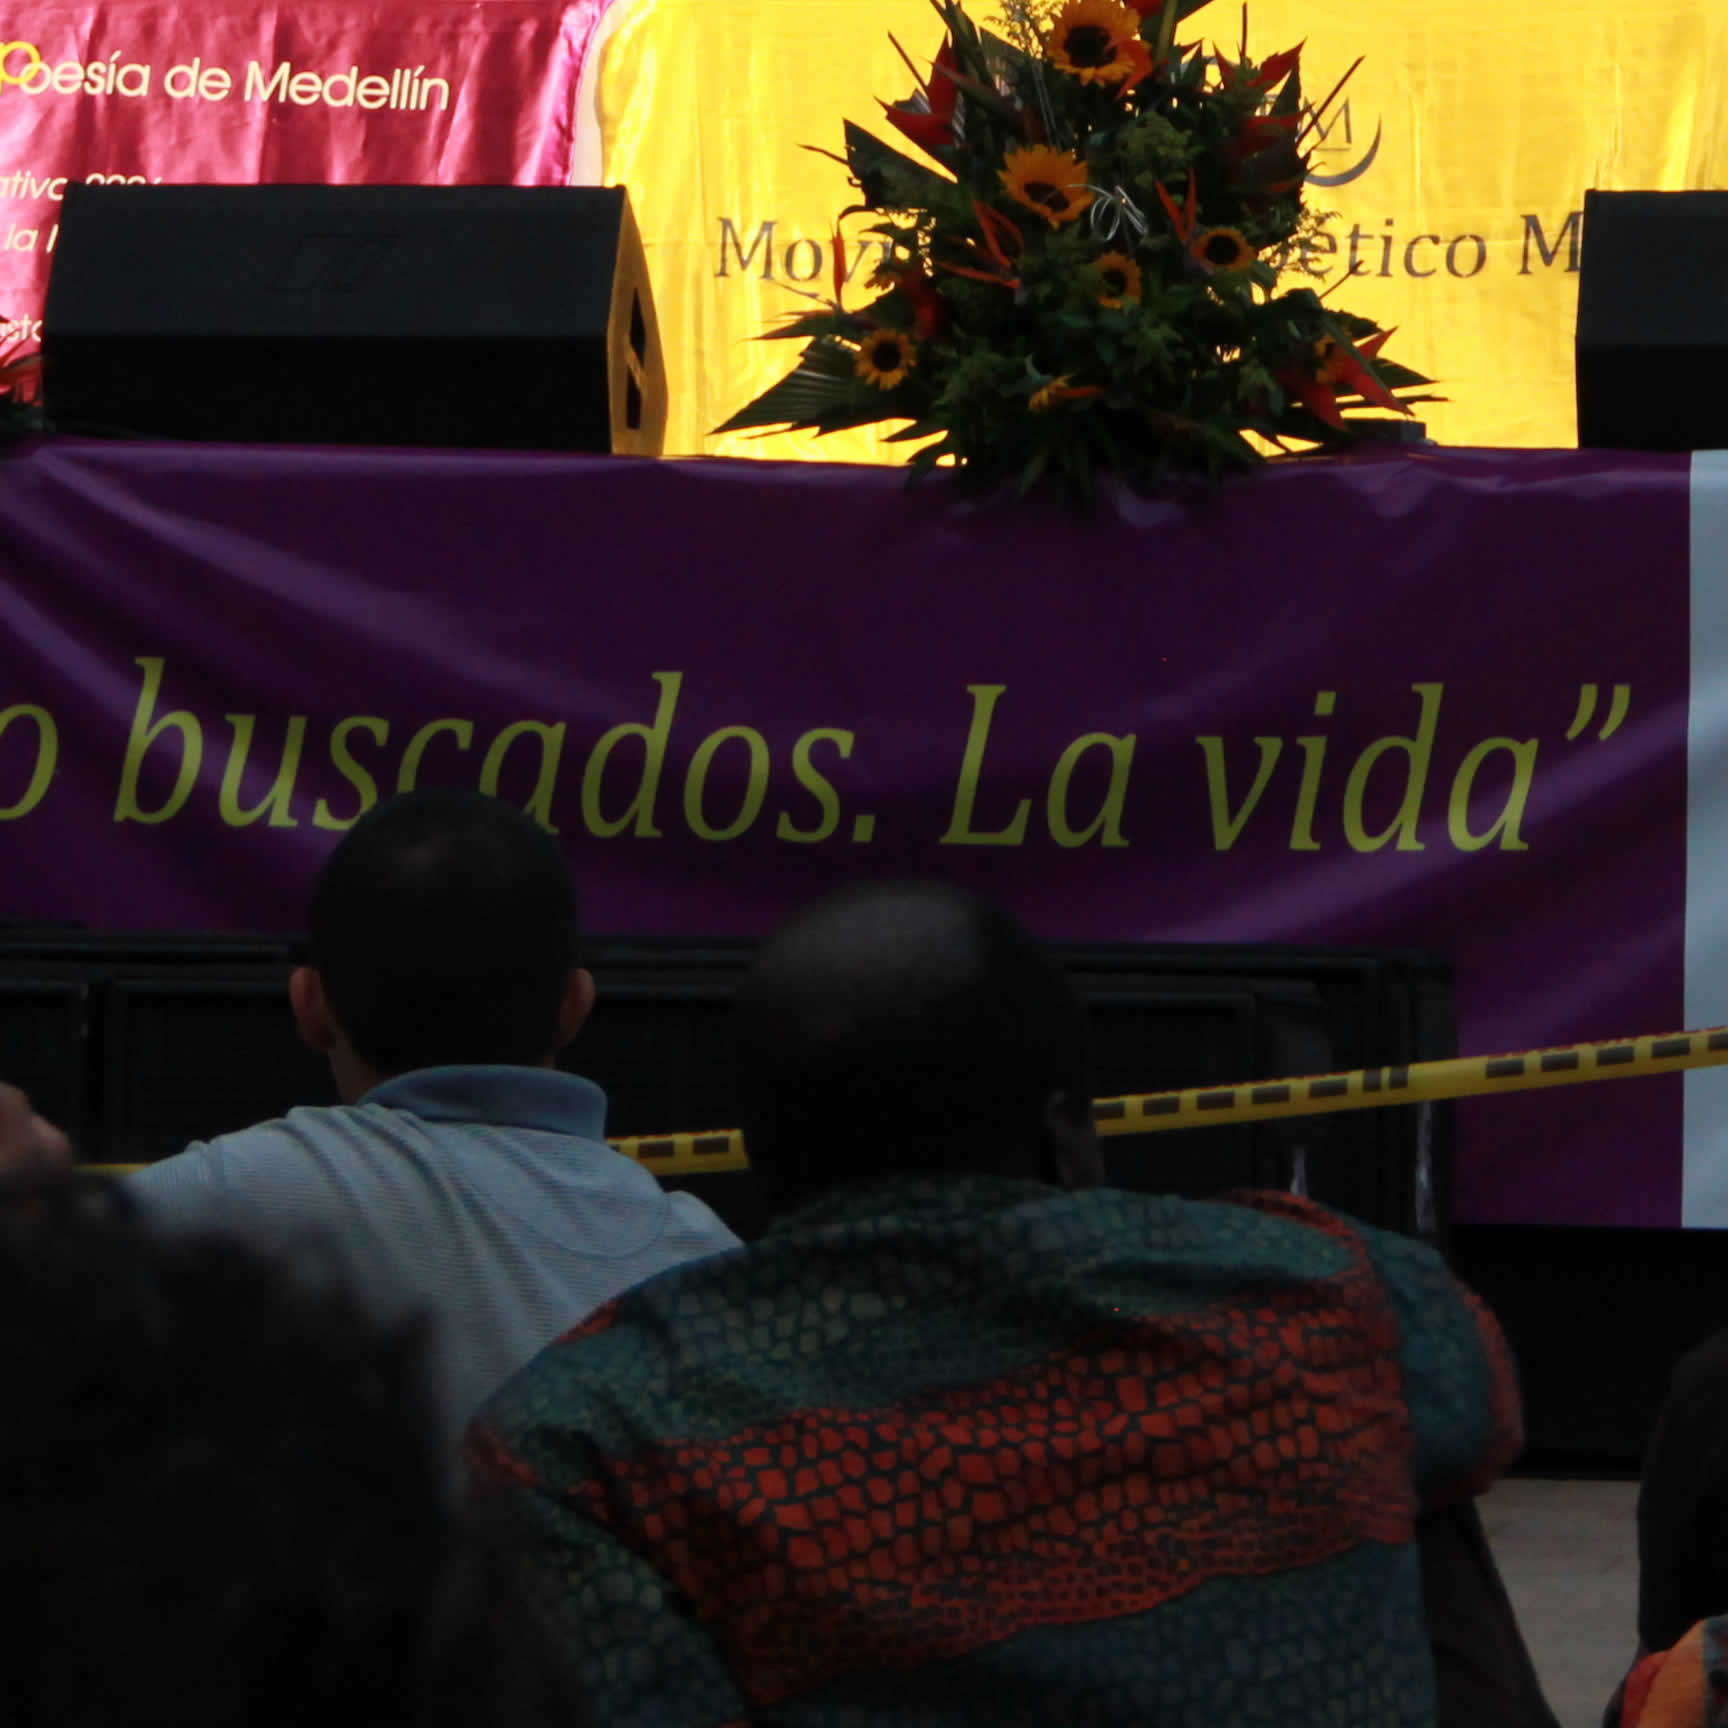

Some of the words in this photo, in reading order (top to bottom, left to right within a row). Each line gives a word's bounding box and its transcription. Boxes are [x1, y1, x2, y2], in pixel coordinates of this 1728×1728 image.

[164, 57, 232, 101] de
[244, 60, 450, 111] Medellín
[112, 656, 876, 843] buscados.
[939, 683, 1137, 848] La
[1194, 682, 1632, 852] vida”
